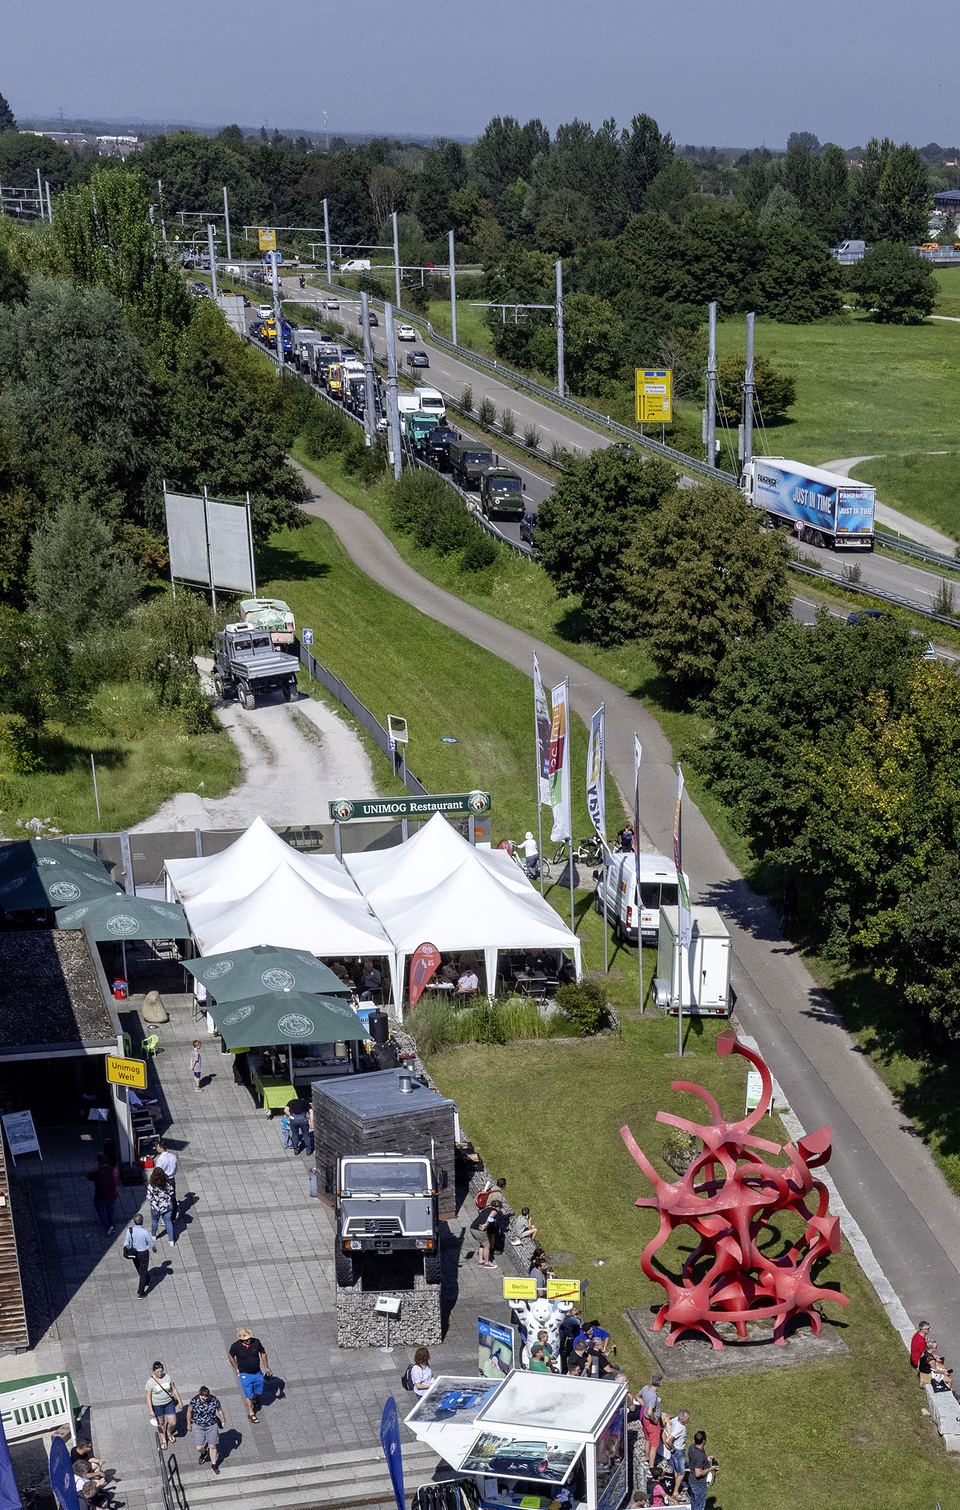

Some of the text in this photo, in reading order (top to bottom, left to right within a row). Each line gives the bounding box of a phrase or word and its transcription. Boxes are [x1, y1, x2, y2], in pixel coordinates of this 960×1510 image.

[757, 474, 777, 487] FAHRNER
[793, 486, 808, 506] JUST
[809, 491, 816, 509] IN
[817, 494, 832, 515] TIME
[363, 803, 407, 814] UNIMOG
[410, 801, 464, 812] Restaurant
[112, 1062, 140, 1074] Unimog
[118, 1072, 135, 1081] Welt
